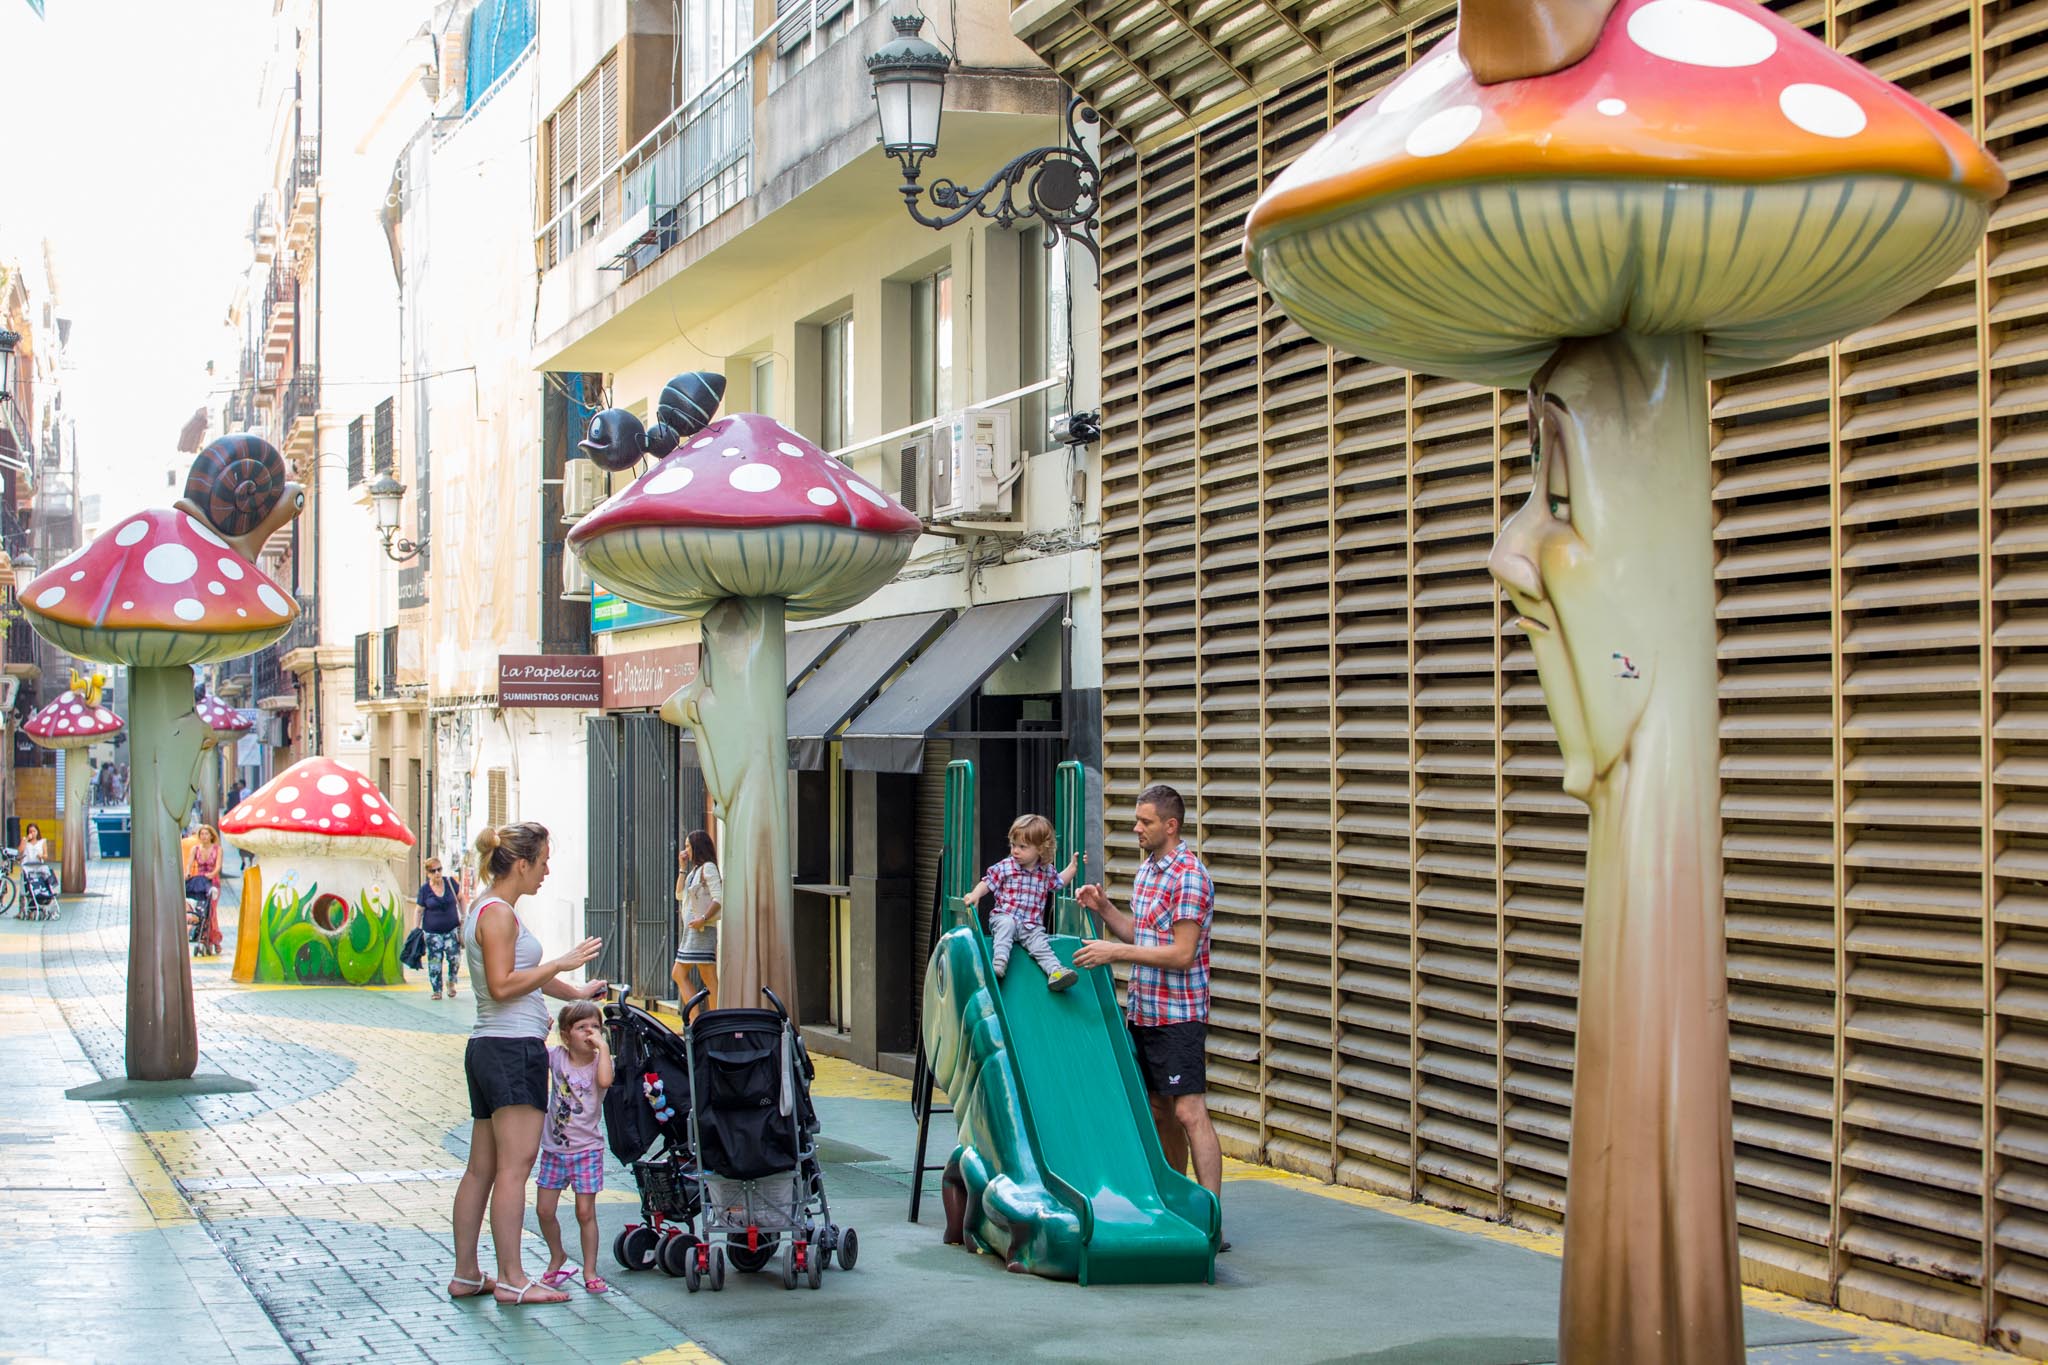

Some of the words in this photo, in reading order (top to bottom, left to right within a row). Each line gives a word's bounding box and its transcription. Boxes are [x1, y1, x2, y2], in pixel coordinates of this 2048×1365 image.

[501, 664, 523, 678] La
[503, 692, 559, 701] SUMINISTROS
[560, 693, 599, 702] OFICINAS
